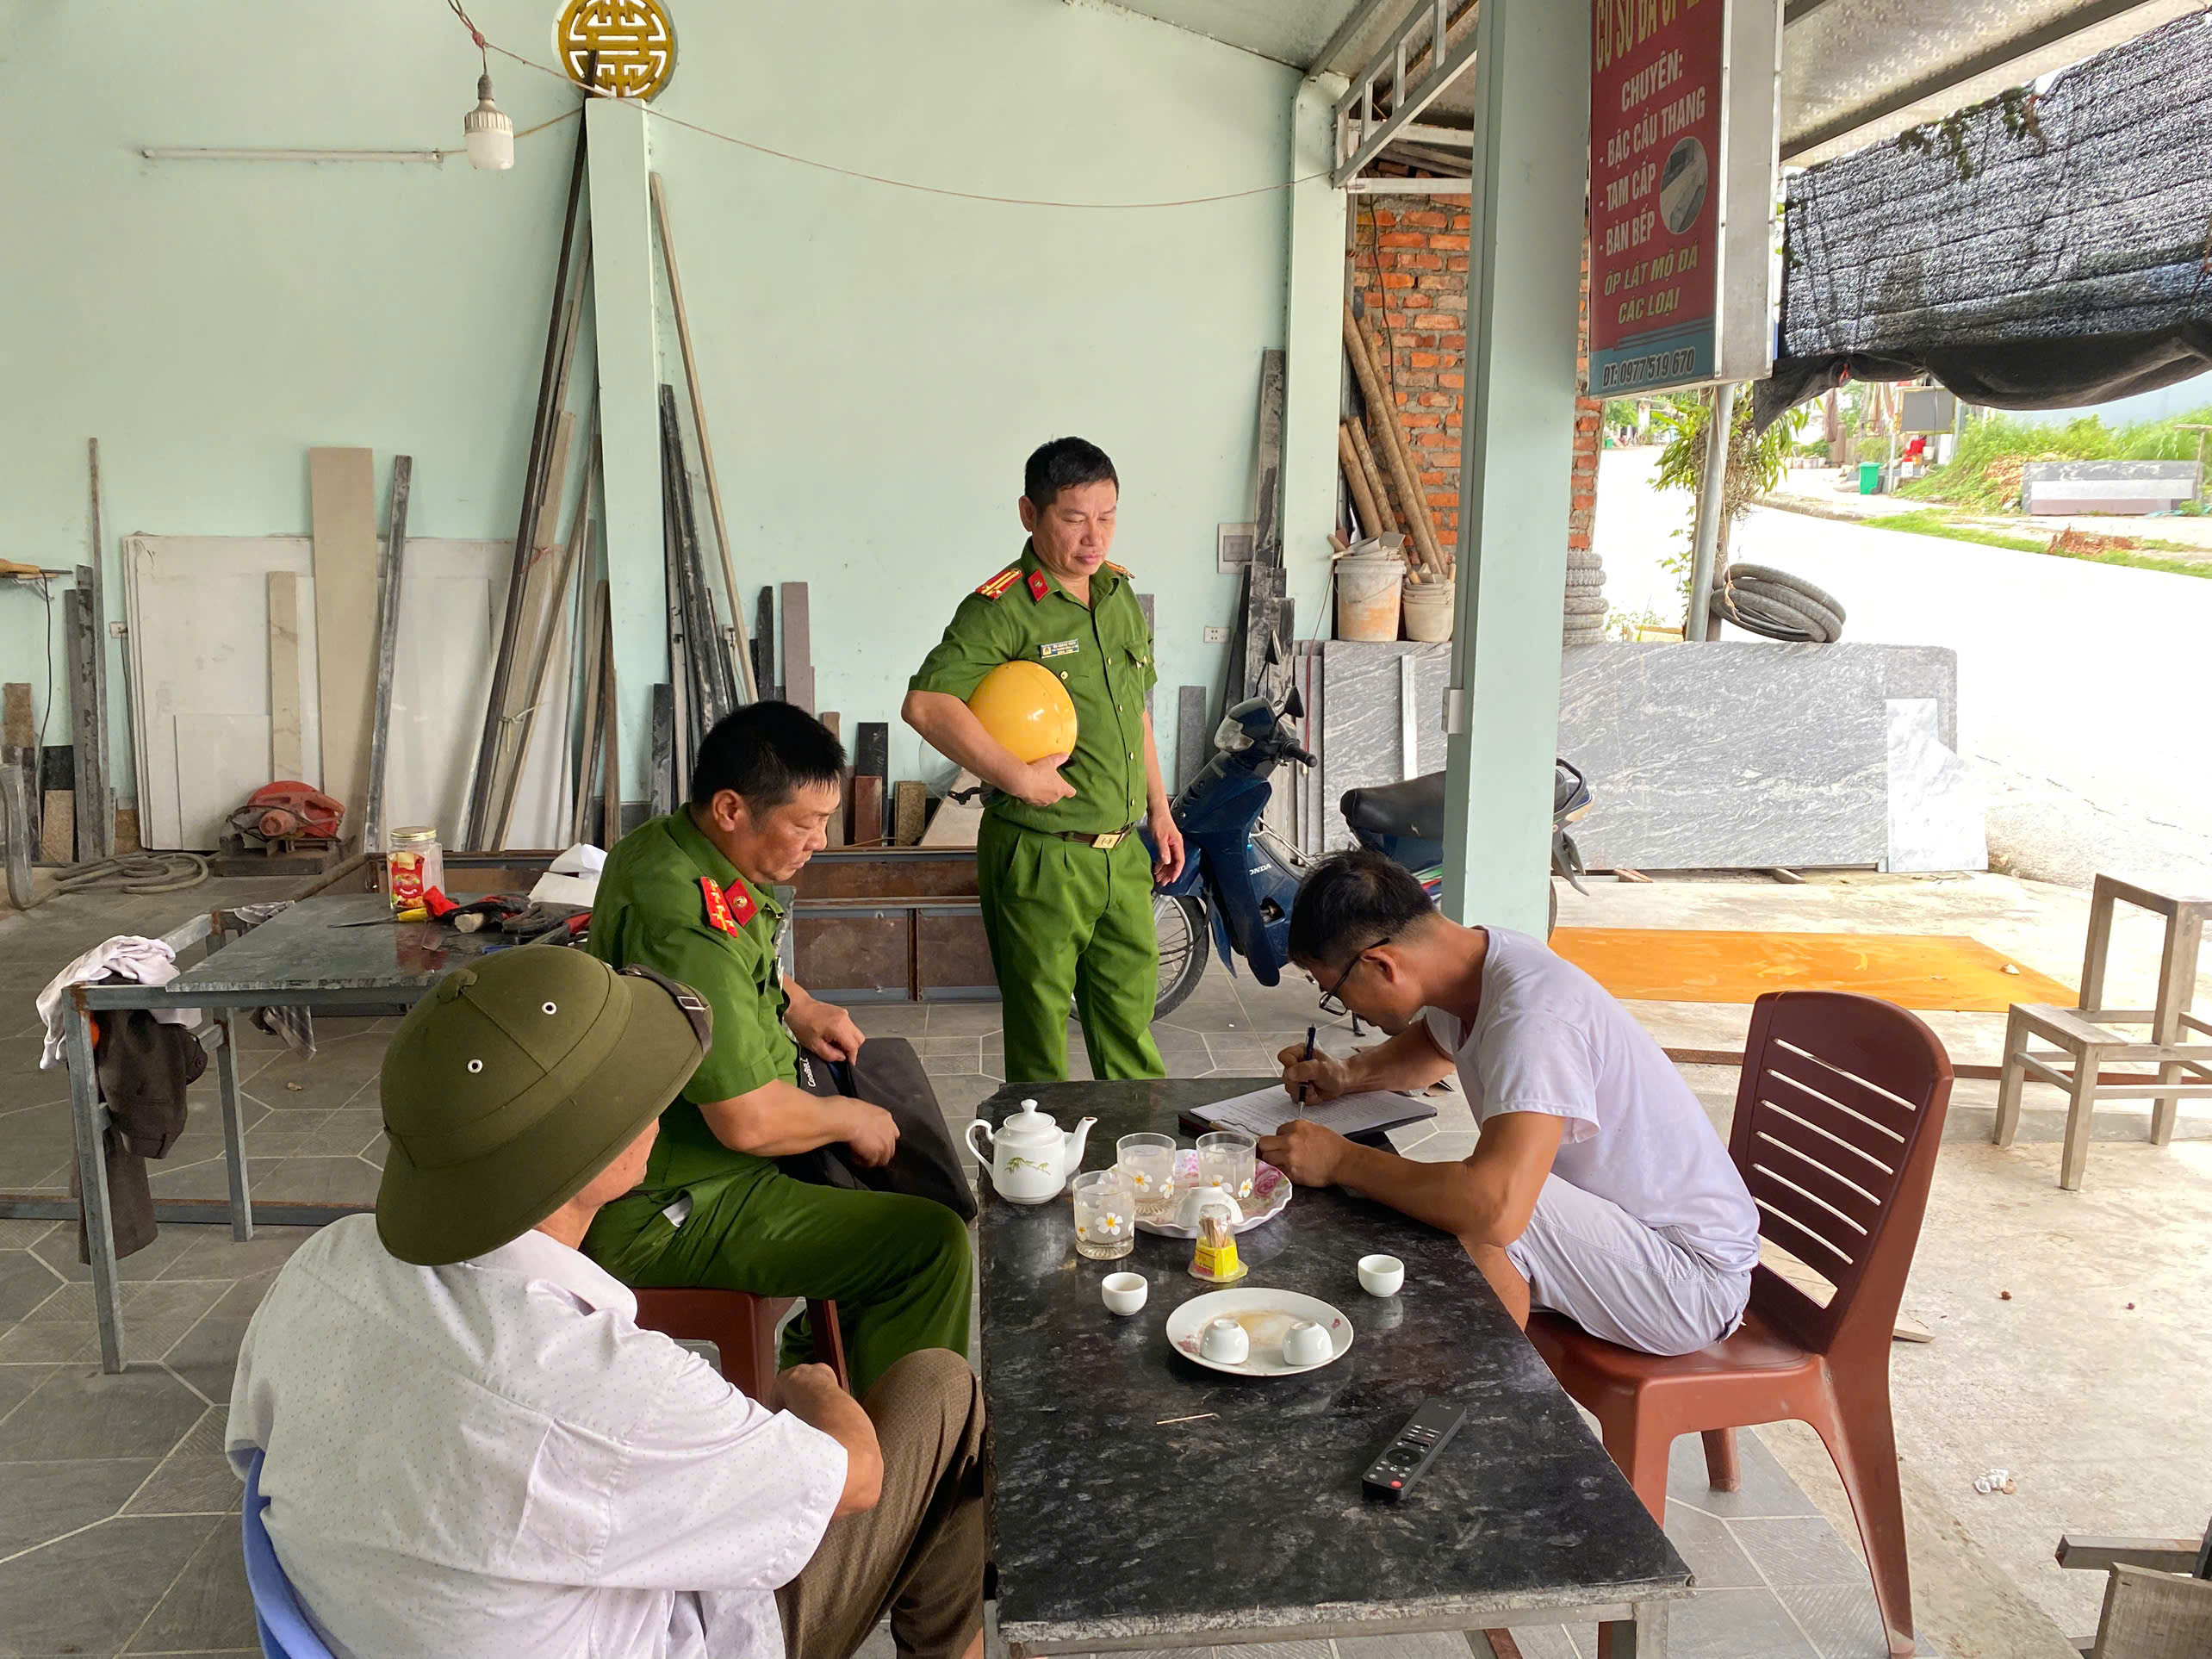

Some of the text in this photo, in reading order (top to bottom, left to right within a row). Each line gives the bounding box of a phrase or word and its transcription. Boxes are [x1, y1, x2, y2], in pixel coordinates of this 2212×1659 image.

[1622, 48, 1683, 112] CHUYÊN:
[1661, 85, 1706, 139] THANG
[1606, 175, 1629, 212] TAM
[1632, 202, 1655, 246] BẾP
[1619, 286, 1681, 324] CÁC LOẠI
[1671, 346, 1695, 376] 670
[1249, 863, 1272, 876] ONDA
